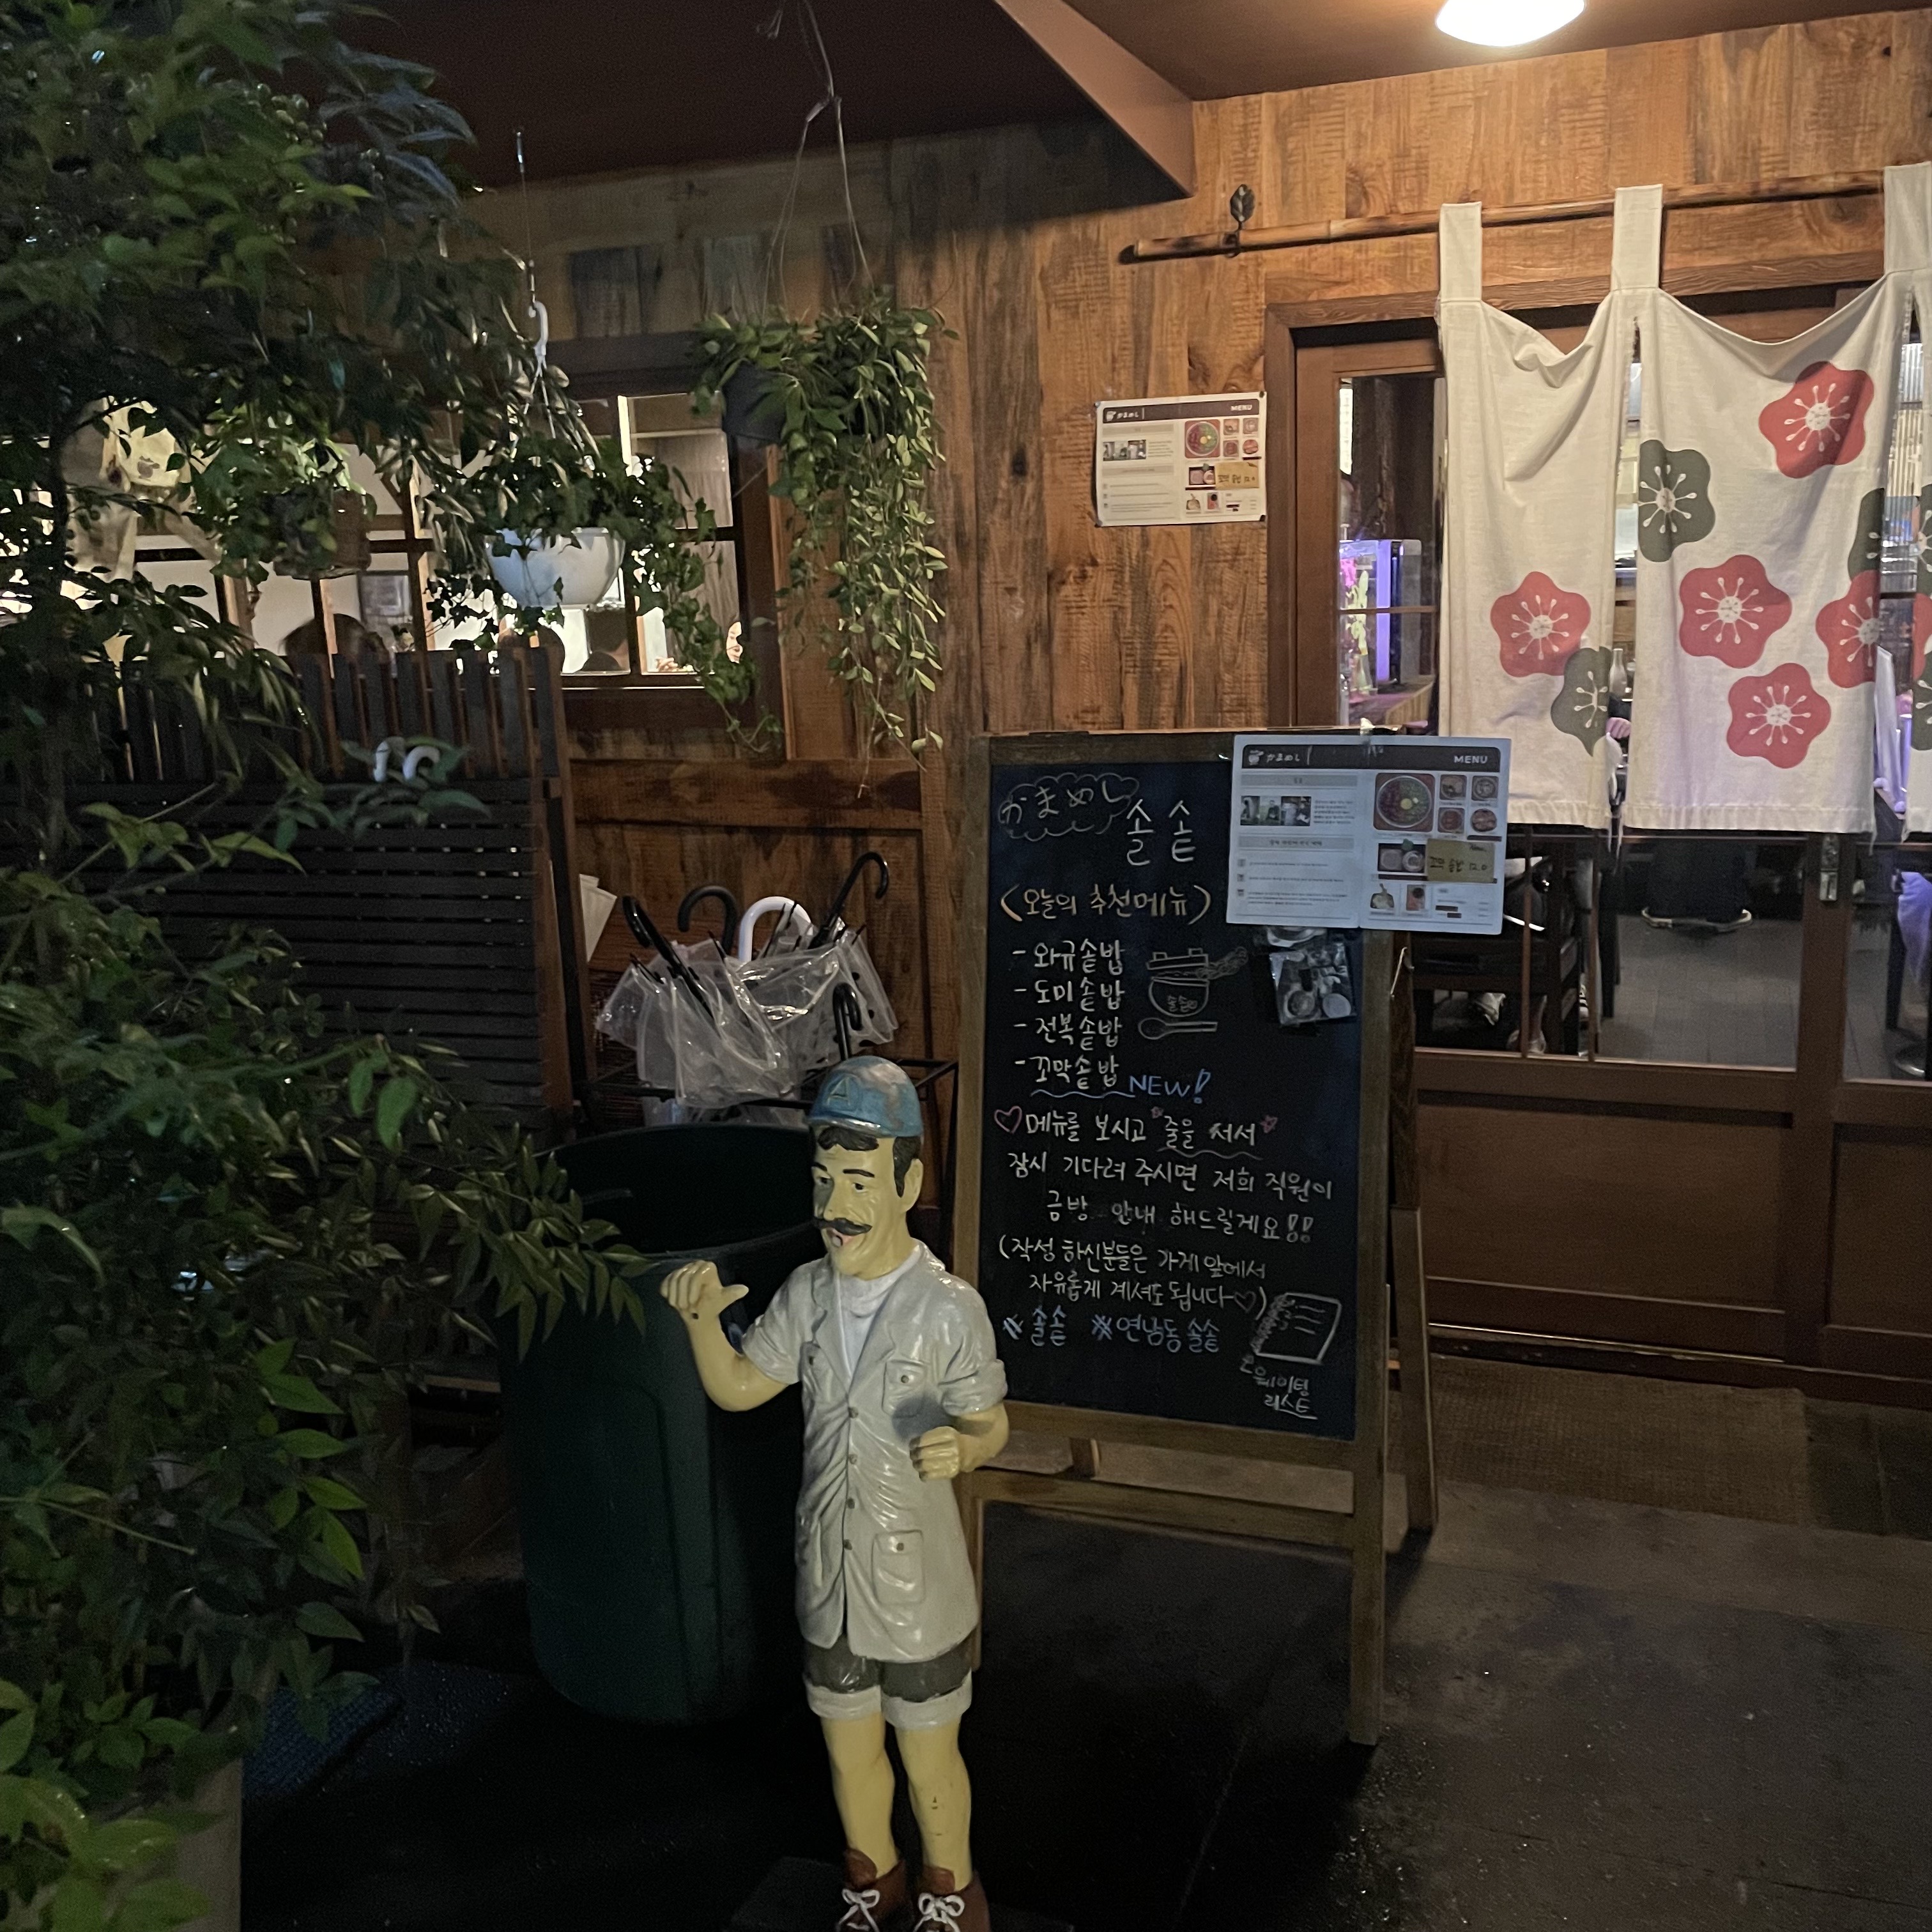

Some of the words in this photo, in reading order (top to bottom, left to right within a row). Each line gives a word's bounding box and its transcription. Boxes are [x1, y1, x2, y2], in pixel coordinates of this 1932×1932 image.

[1453, 755, 1488, 763] MENU
[1034, 939, 1125, 976] 와규솥밥
[1034, 976, 1125, 1012] 도미솥밥
[1035, 1013, 1123, 1051] 전복솥밥
[1129, 1068, 1211, 1104] NEW!
[1025, 1110, 1080, 1142] 메뉴를
[1095, 1114, 1147, 1142] 보시고
[1163, 1116, 1195, 1149] 줄을
[1209, 1123, 1255, 1146] 서서
[1008, 1151, 1047, 1178] 잠시
[1063, 1156, 1126, 1181] 기다려
[1135, 1158, 1197, 1192] 주시면
[1213, 1167, 1254, 1192] 저희
[1265, 1171, 1332, 1203] 직원이
[1046, 1190, 1088, 1222] 금방
[1112, 1200, 1156, 1225] 안내
[1158, 1250, 1199, 1272] 가게
[1029, 1269, 1101, 1301] 자유롭게
[1263, 1393, 1311, 1413] 리스트
